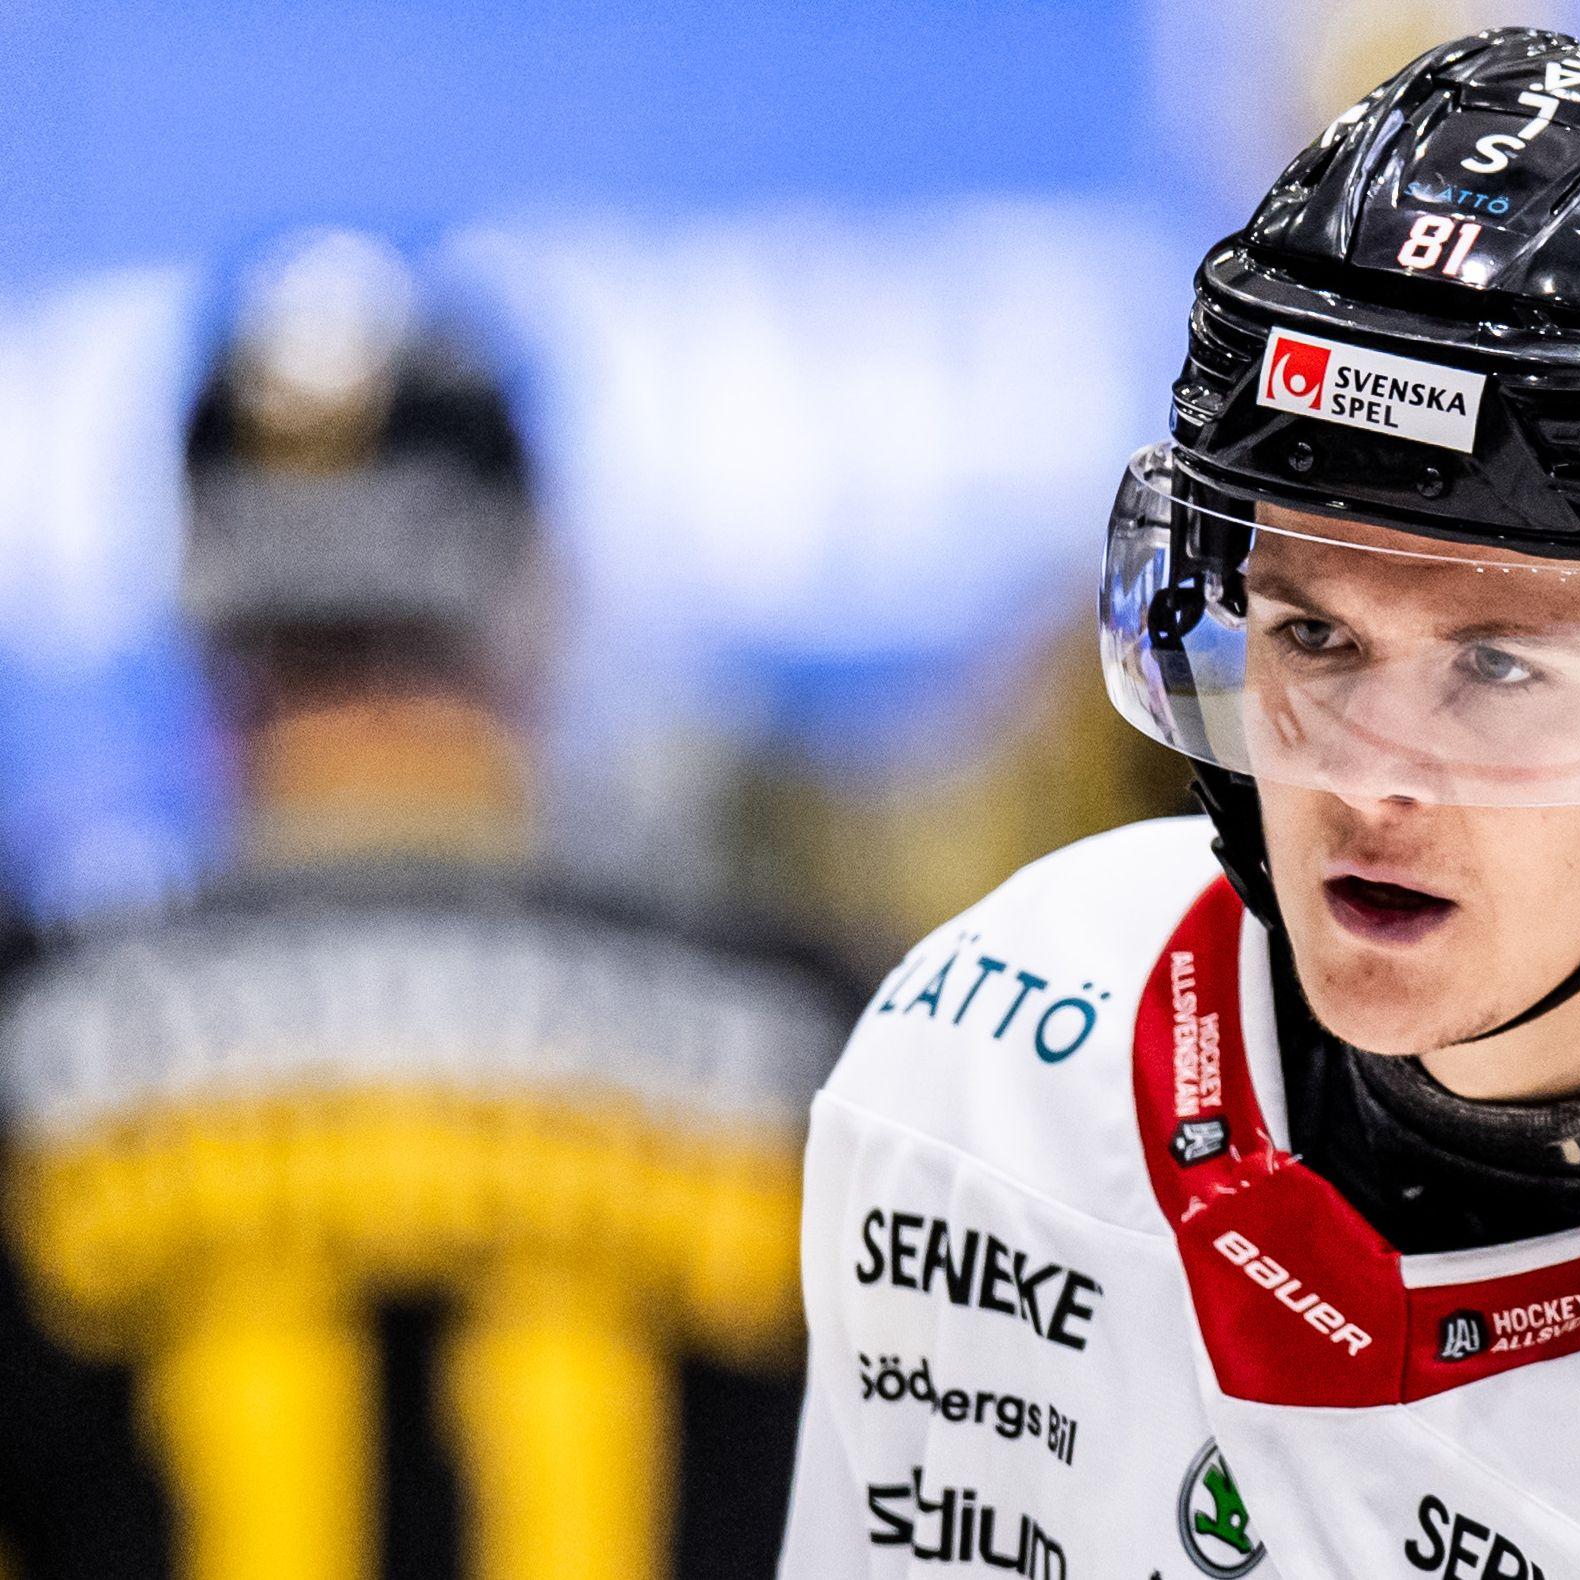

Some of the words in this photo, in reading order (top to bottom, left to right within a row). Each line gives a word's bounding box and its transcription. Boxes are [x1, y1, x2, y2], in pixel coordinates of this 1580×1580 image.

[1404, 179, 1510, 214] SLÄTTÖ
[1397, 215, 1483, 276] 81
[1331, 393, 1399, 429] SPEL
[1334, 366, 1467, 417] SVENSKA
[1213, 1230, 1372, 1357] BAUER
[1048, 1402, 1078, 1467] Bil
